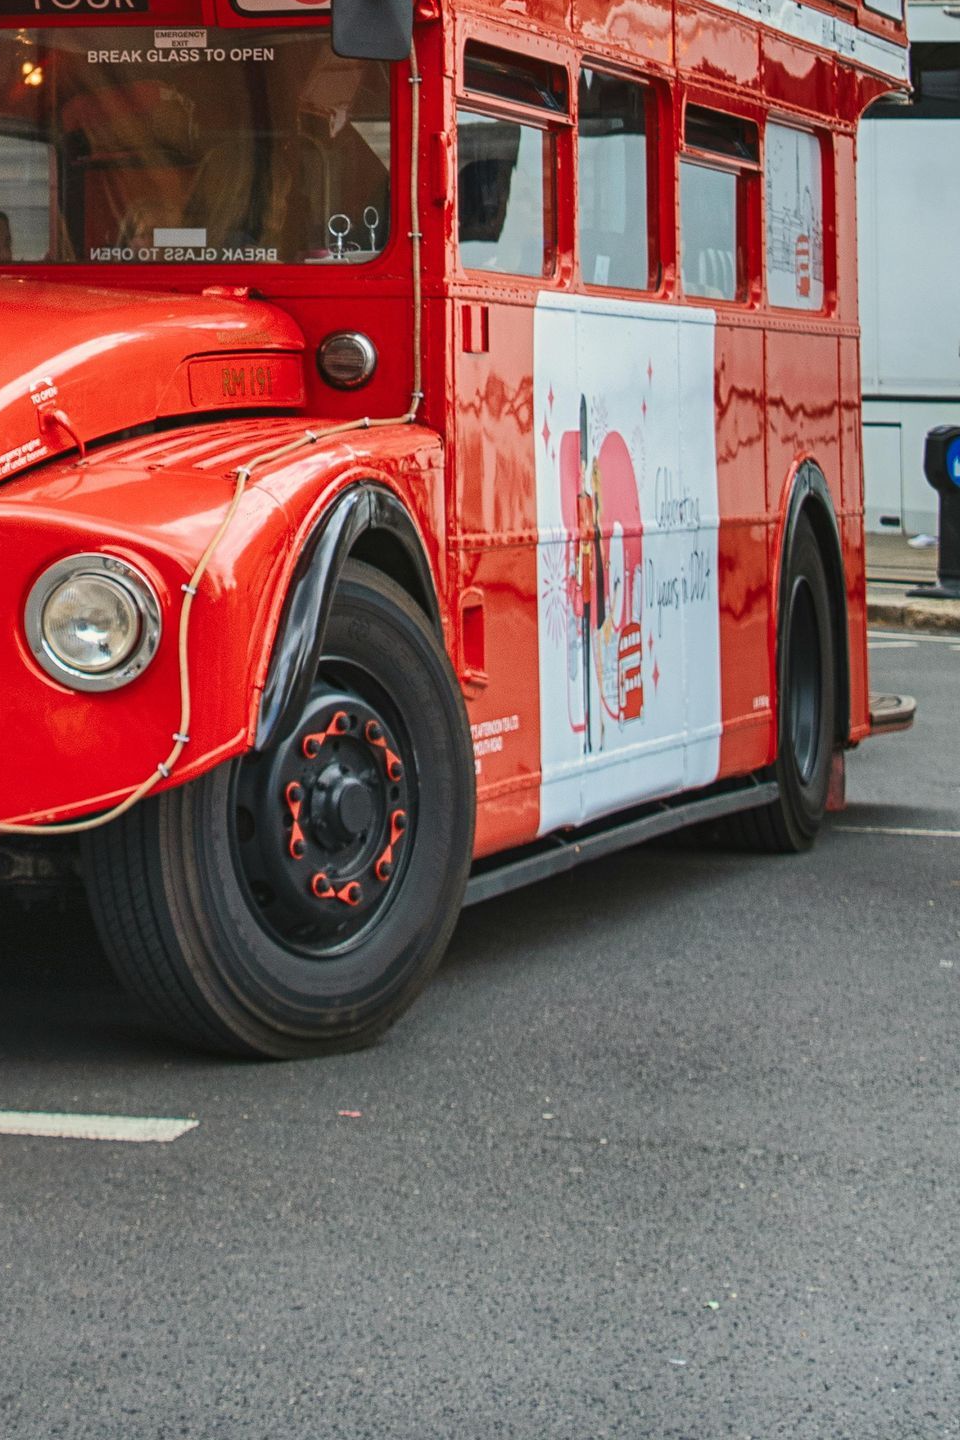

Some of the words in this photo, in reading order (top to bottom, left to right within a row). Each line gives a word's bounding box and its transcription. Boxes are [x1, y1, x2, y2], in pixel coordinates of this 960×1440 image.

[87, 50, 142, 63] BREAK
[146, 49, 200, 62] GLASS
[204, 48, 226, 62] TO
[230, 48, 275, 61] OPEN
[221, 368, 246, 397] RM
[249, 366, 273, 396] 191
